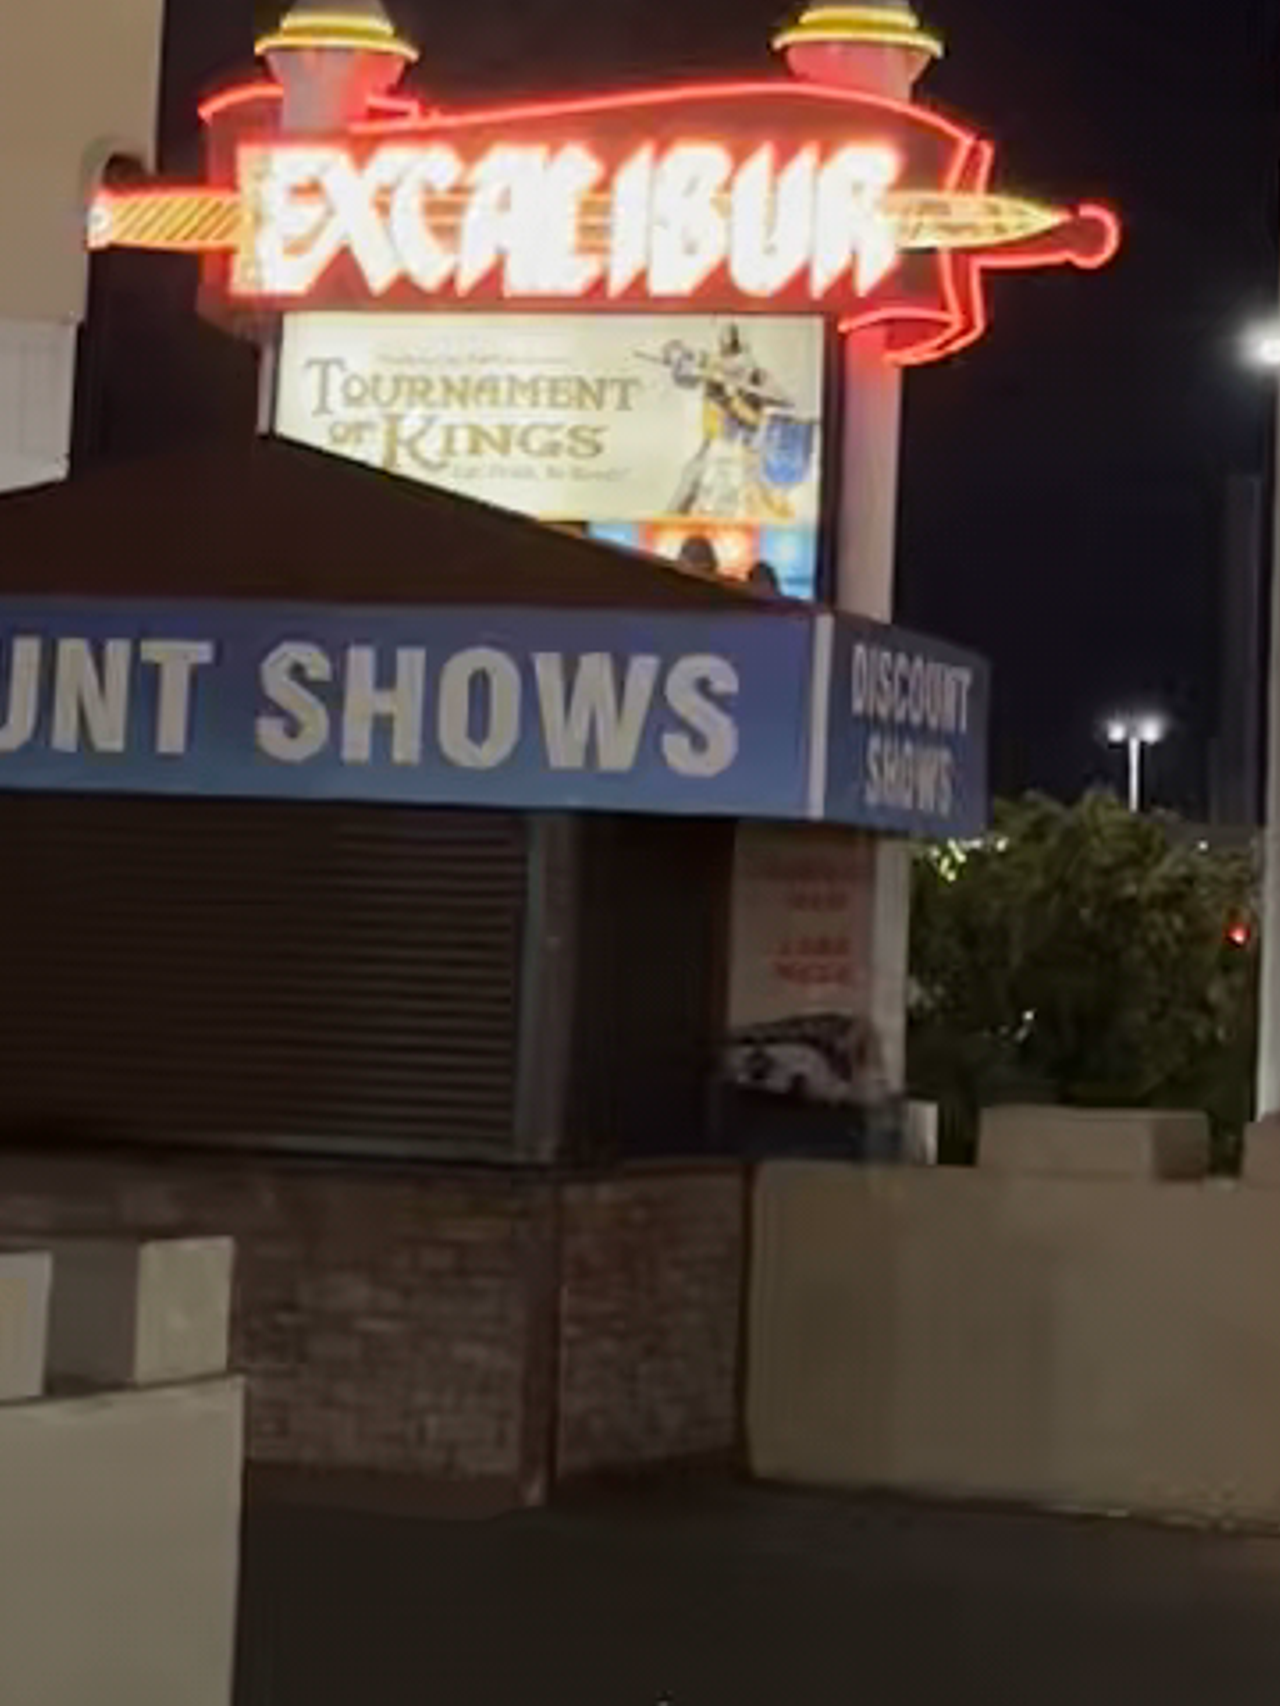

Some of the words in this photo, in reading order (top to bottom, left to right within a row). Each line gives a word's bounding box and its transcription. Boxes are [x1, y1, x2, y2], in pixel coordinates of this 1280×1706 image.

[230, 139, 907, 298] EXCALIBUR
[304, 356, 642, 417] TOURNAMENT
[379, 413, 609, 471] KINGS
[254, 640, 740, 778] SHOWS
[850, 642, 972, 735] DISCOUNT
[864, 732, 954, 819] SHOWS
